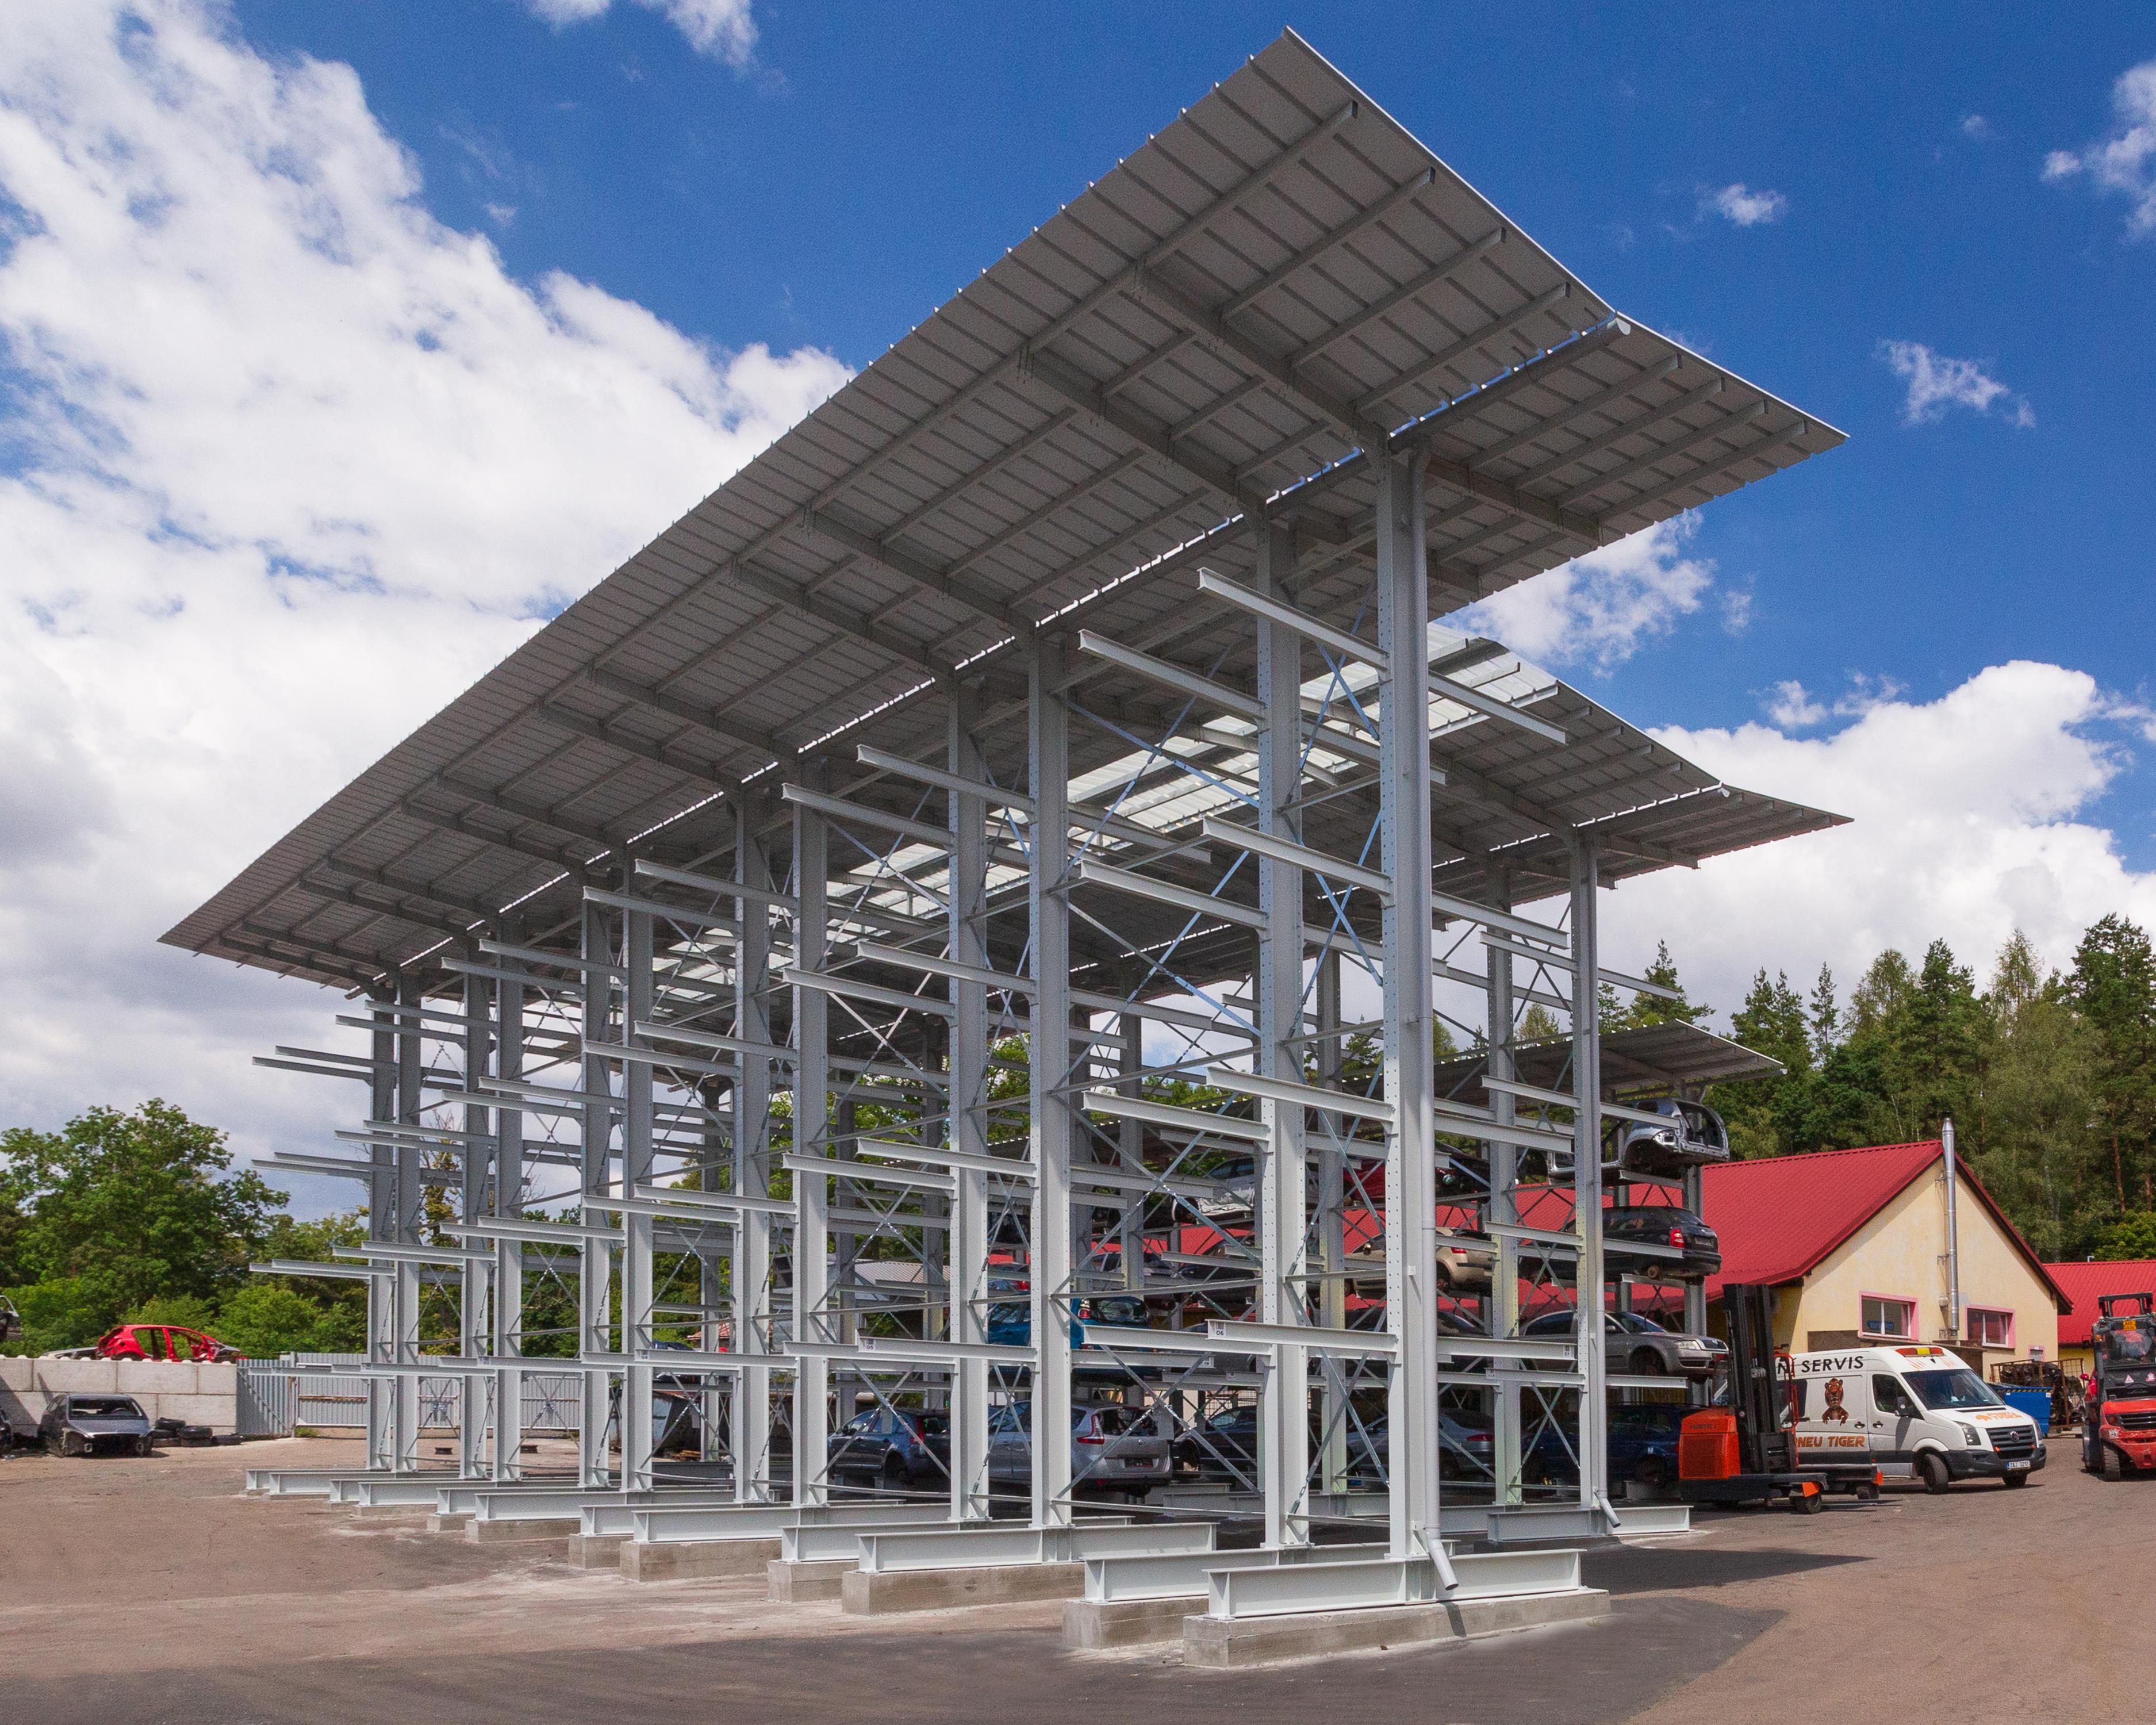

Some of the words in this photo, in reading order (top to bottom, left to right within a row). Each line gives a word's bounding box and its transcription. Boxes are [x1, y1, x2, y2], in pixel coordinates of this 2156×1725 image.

[1801, 1356, 1864, 1373] SERVIS
[1795, 1436, 1823, 1447] NEU
[1828, 1435, 1865, 1447] TIGER
